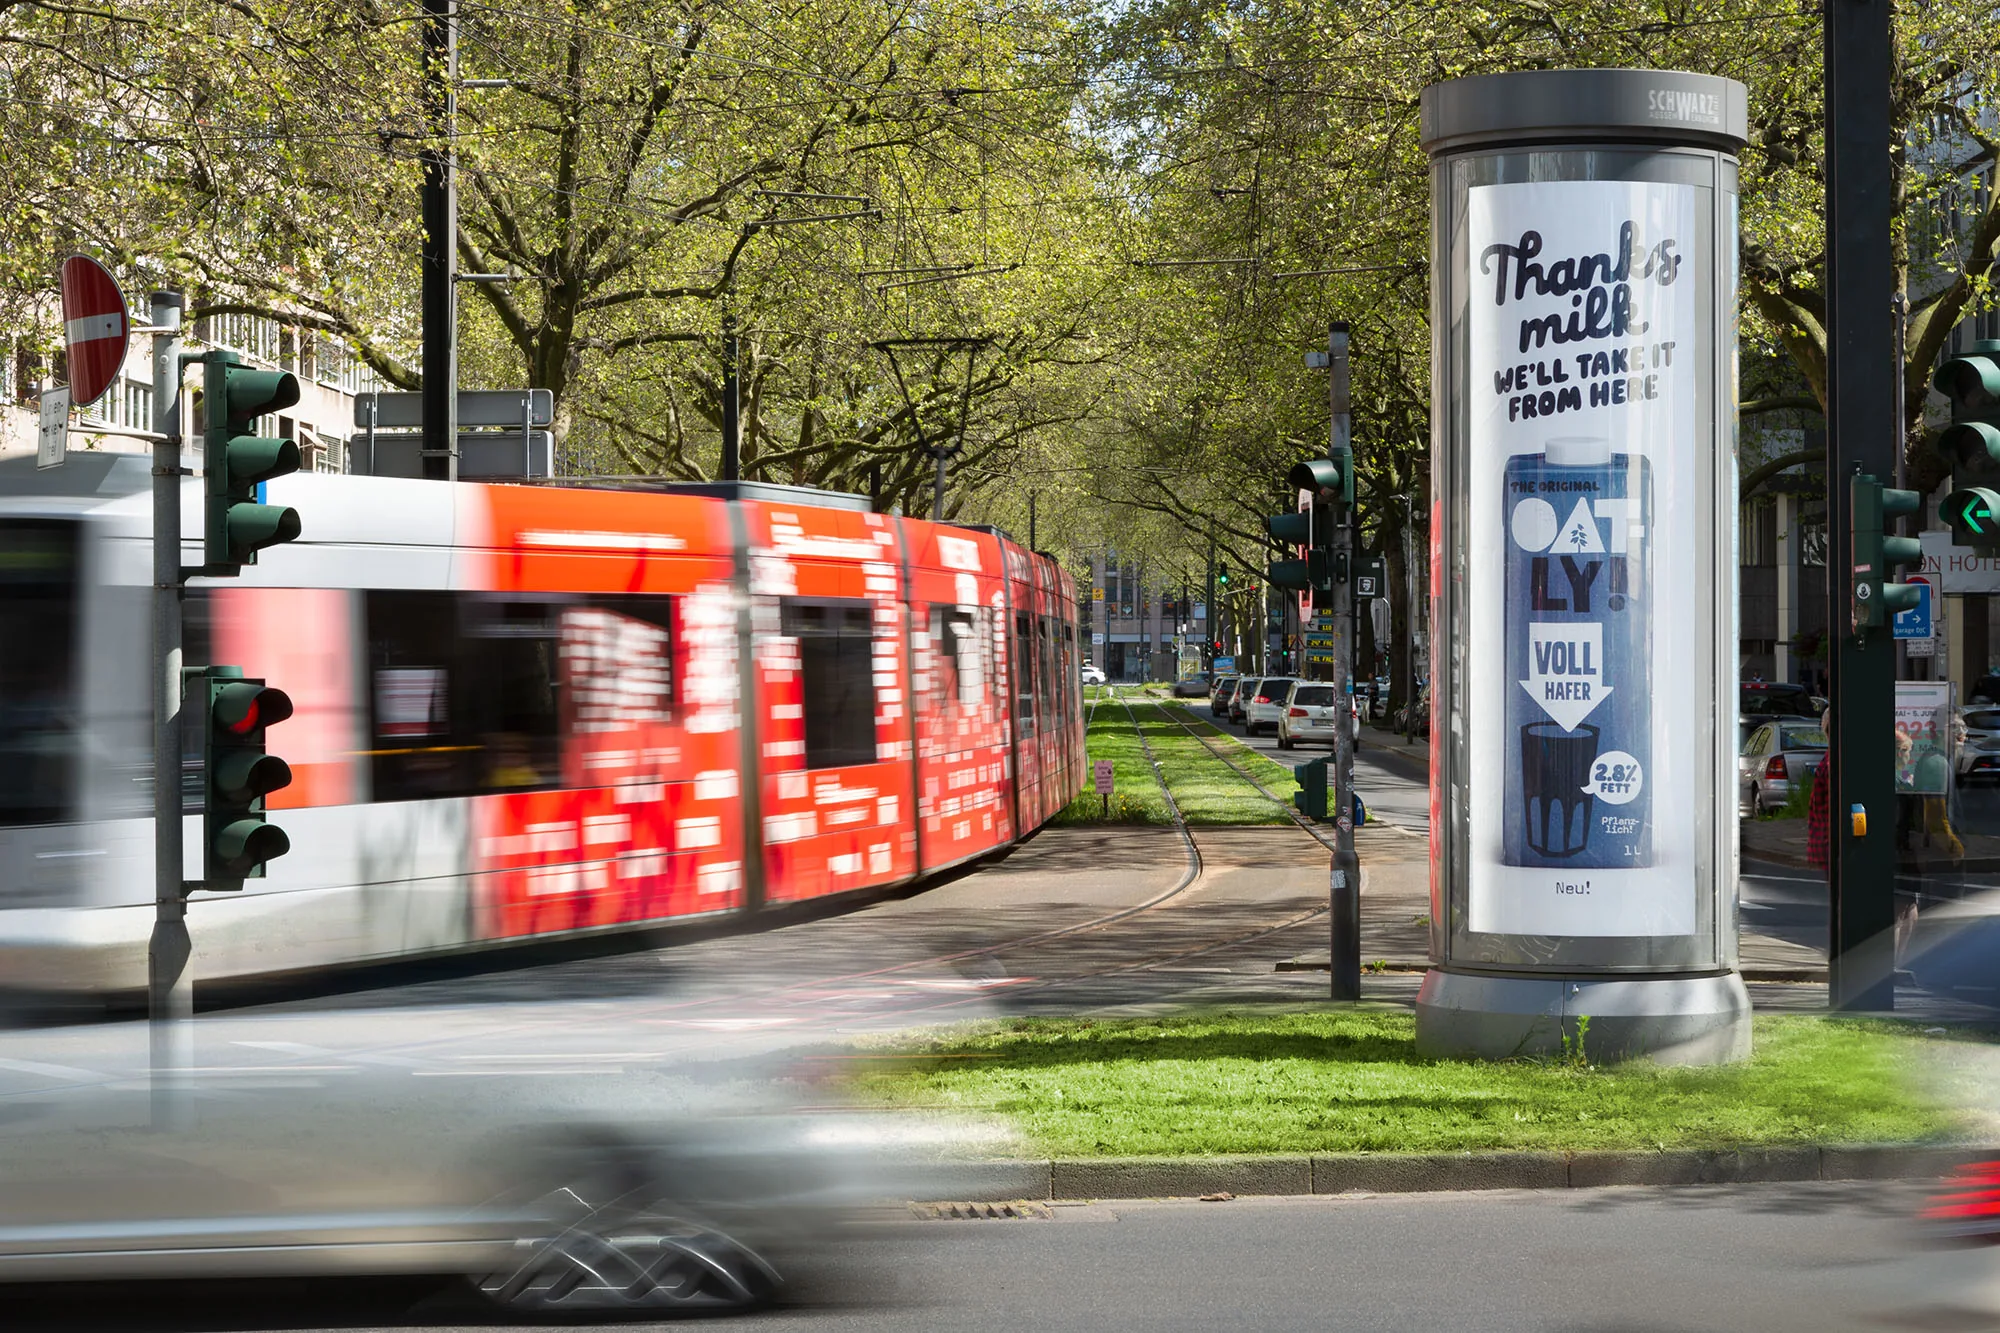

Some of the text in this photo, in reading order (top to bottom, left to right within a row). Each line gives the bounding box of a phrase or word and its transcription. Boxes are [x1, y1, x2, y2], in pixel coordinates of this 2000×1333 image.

[1648, 90, 1714, 121] SCHWARZ
[1480, 220, 1682, 306] Thanks
[1519, 283, 1650, 353] milk
[1494, 341, 1676, 395] WE'LL TAKE IT
[1509, 374, 1659, 422] FROM HERE
[1510, 480, 1601, 493] THE ORIGINAL
[1511, 496, 1641, 553] OAT
[1530, 555, 1629, 612] LY!
[1534, 641, 1597, 675] VOLL
[1545, 681, 1592, 700] HAFER
[1594, 763, 1638, 782] 2.8%
[1600, 782, 1631, 794] FETT
[1601, 816, 1640, 826] Pflanz-
[1605, 825, 1633, 834] lich!
[1556, 880, 1591, 895] Neu!
